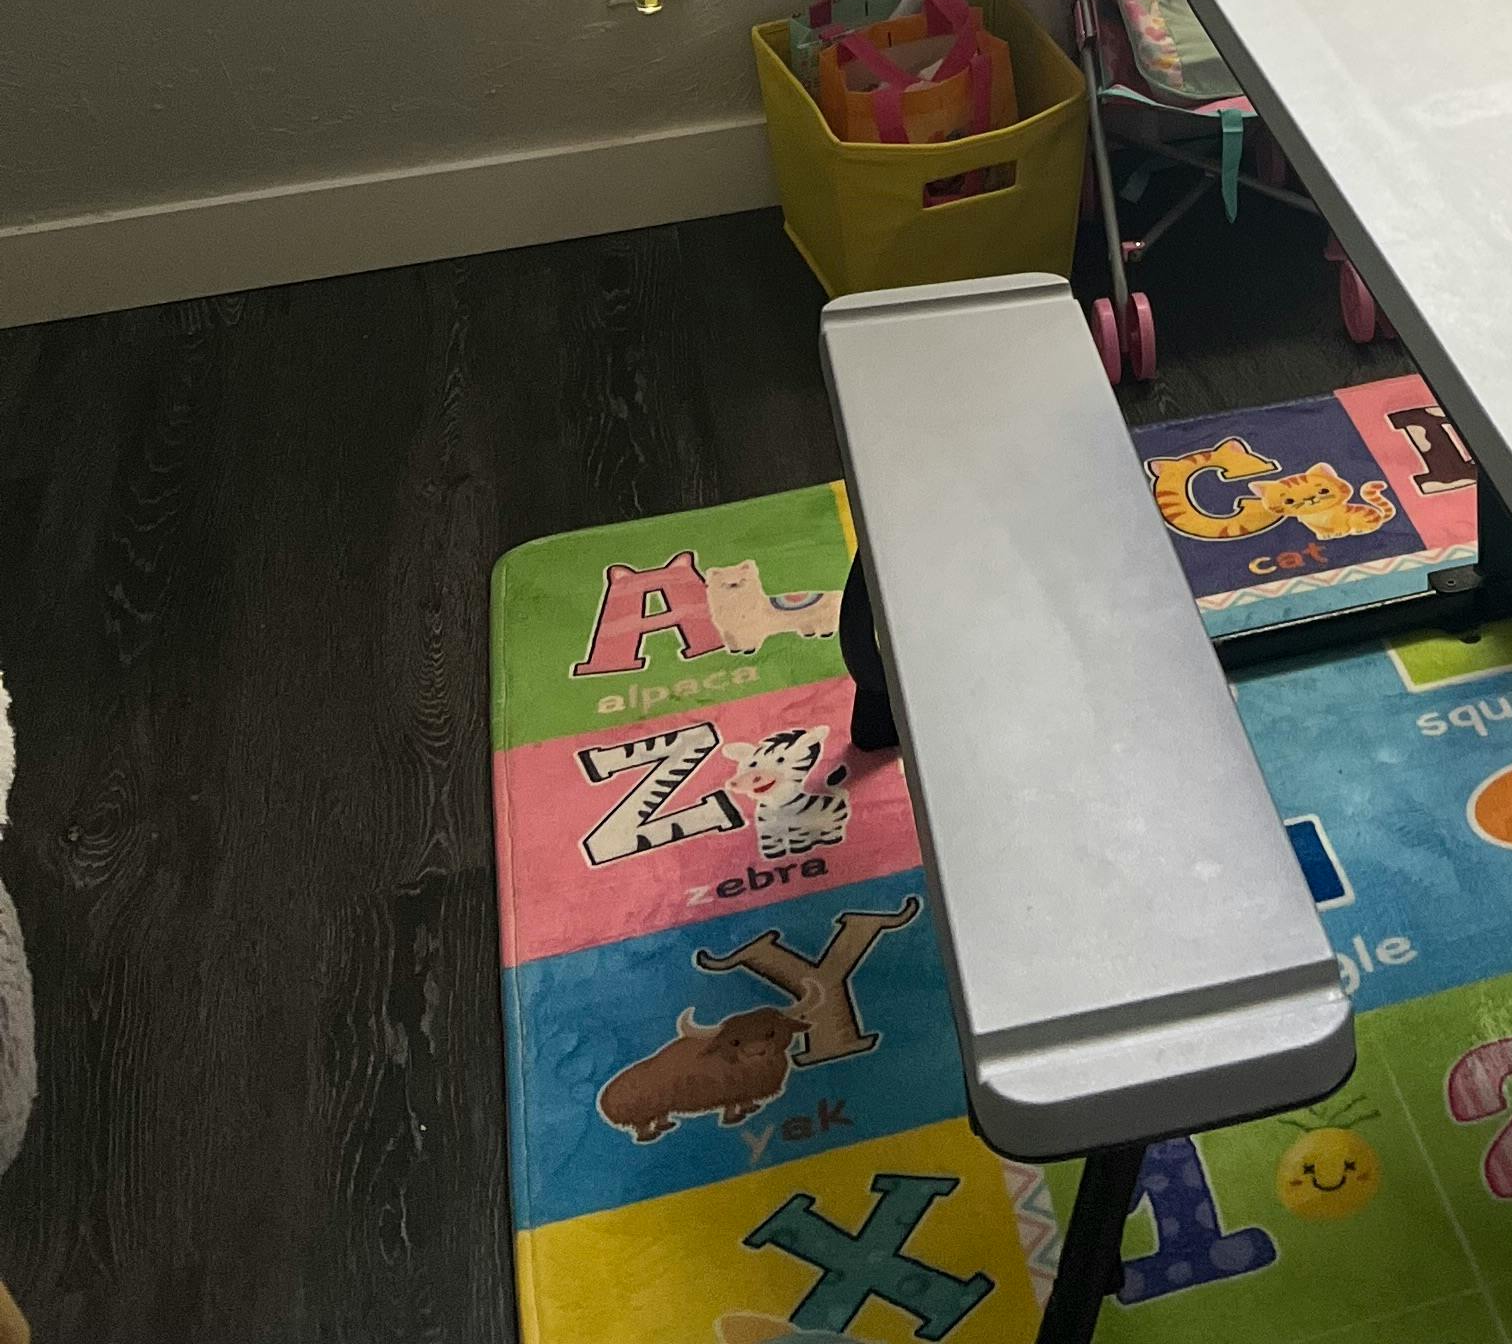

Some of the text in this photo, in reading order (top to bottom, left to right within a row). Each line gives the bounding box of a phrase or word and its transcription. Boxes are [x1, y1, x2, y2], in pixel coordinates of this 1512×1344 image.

[1144, 436, 1282, 540] C
[572, 550, 728, 676] A
[1246, 541, 1328, 575] cat
[597, 661, 759, 716] alpaca
[576, 721, 744, 868] Z
[684, 853, 829, 908] zebra
[695, 897, 921, 1066] Y
[741, 1099, 854, 1162] yak
[742, 1172, 998, 1344] X
[1112, 1132, 1280, 1307] 1
